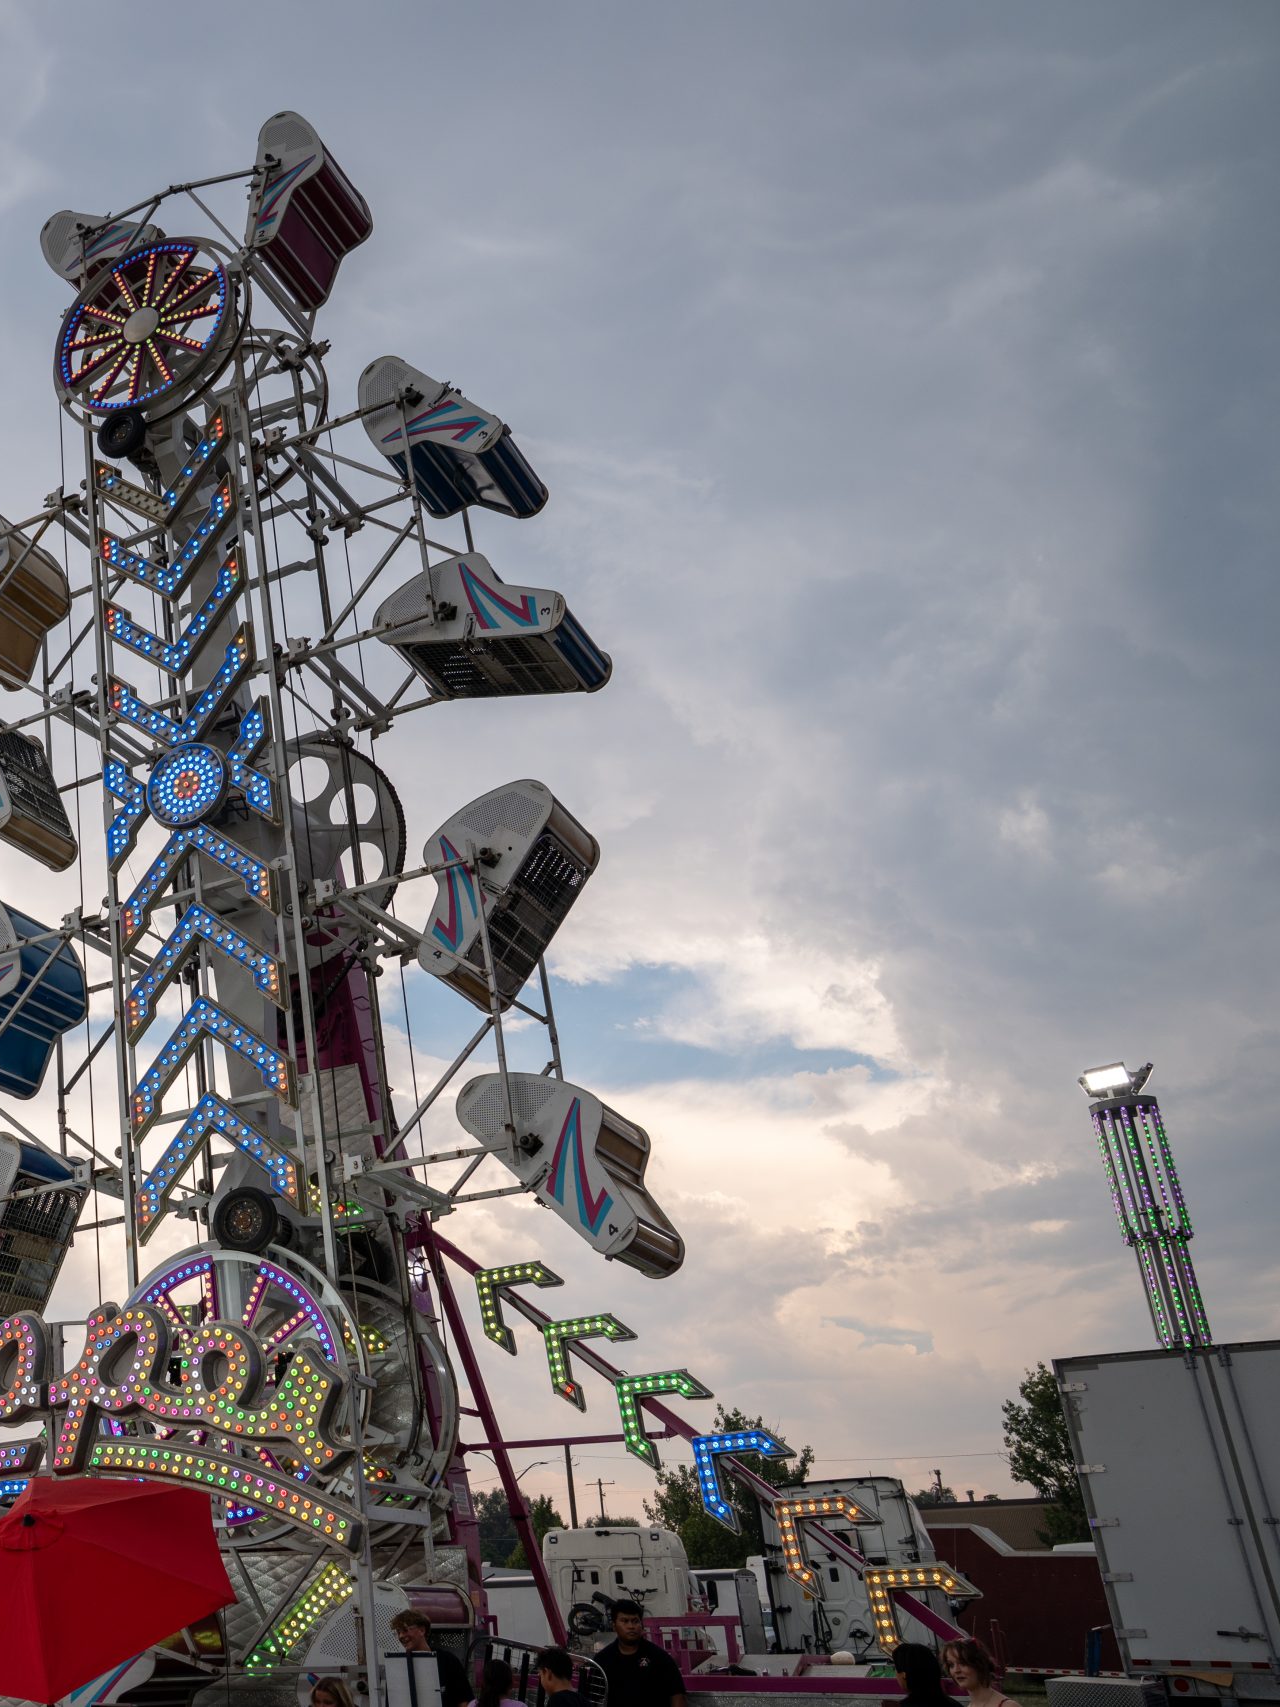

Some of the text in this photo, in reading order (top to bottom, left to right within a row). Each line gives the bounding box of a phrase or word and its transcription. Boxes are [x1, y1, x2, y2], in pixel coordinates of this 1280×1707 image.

[478, 430, 488, 439] 3
[540, 606, 551, 616] 3
[433, 950, 442, 959] 4
[608, 1223, 619, 1236] 4
